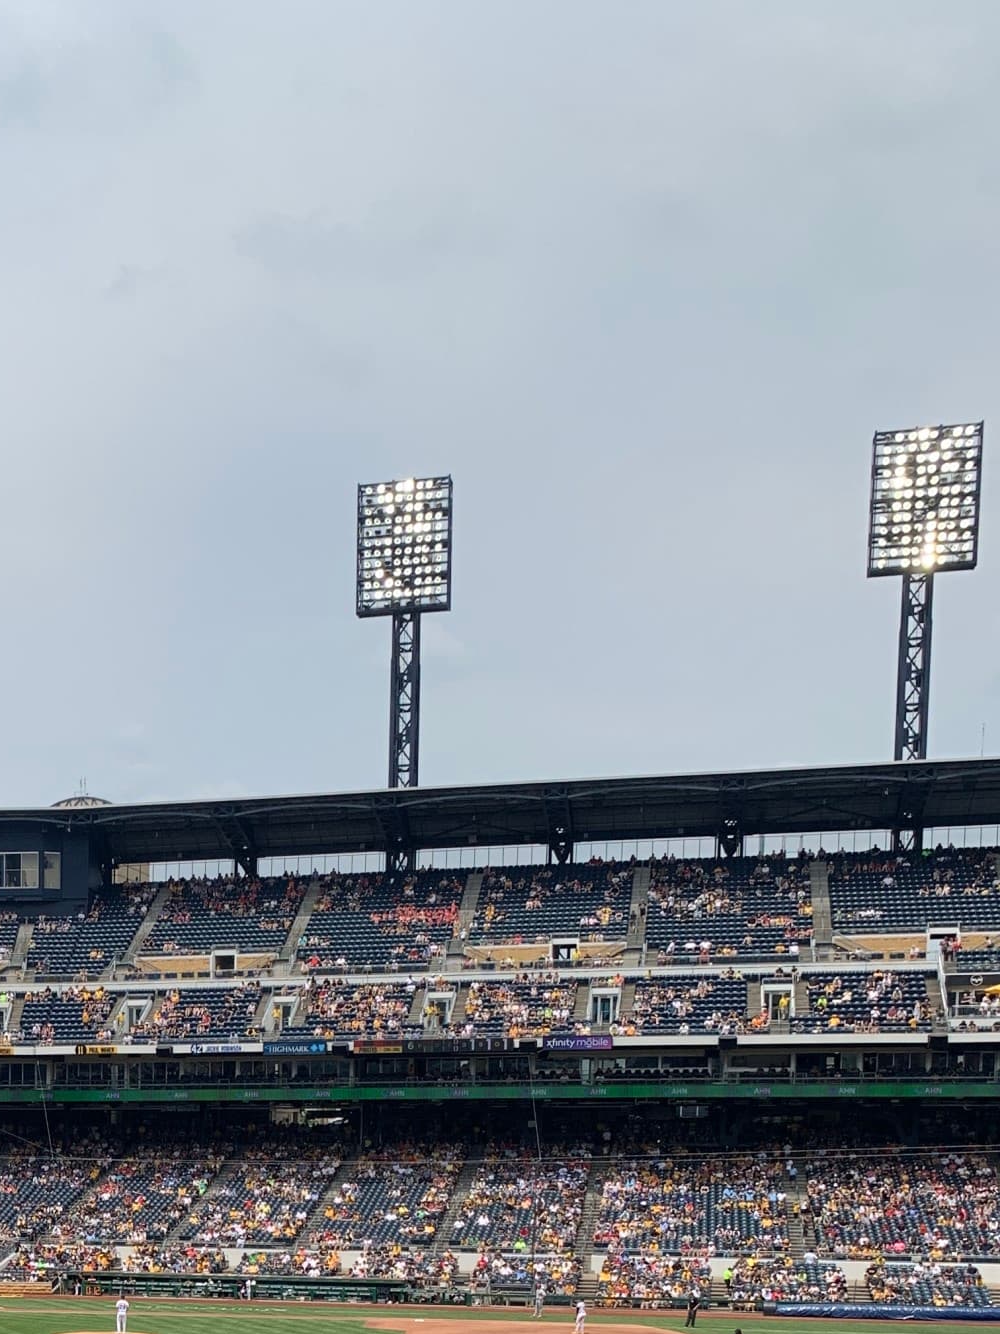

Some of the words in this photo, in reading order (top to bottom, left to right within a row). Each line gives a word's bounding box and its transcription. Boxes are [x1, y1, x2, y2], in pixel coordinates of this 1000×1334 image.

[546, 1038, 576, 1048] xfinity
[576, 1037, 609, 1047] mobile
[191, 1043, 203, 1054] 42
[267, 1045, 309, 1053] HIGHMARK
